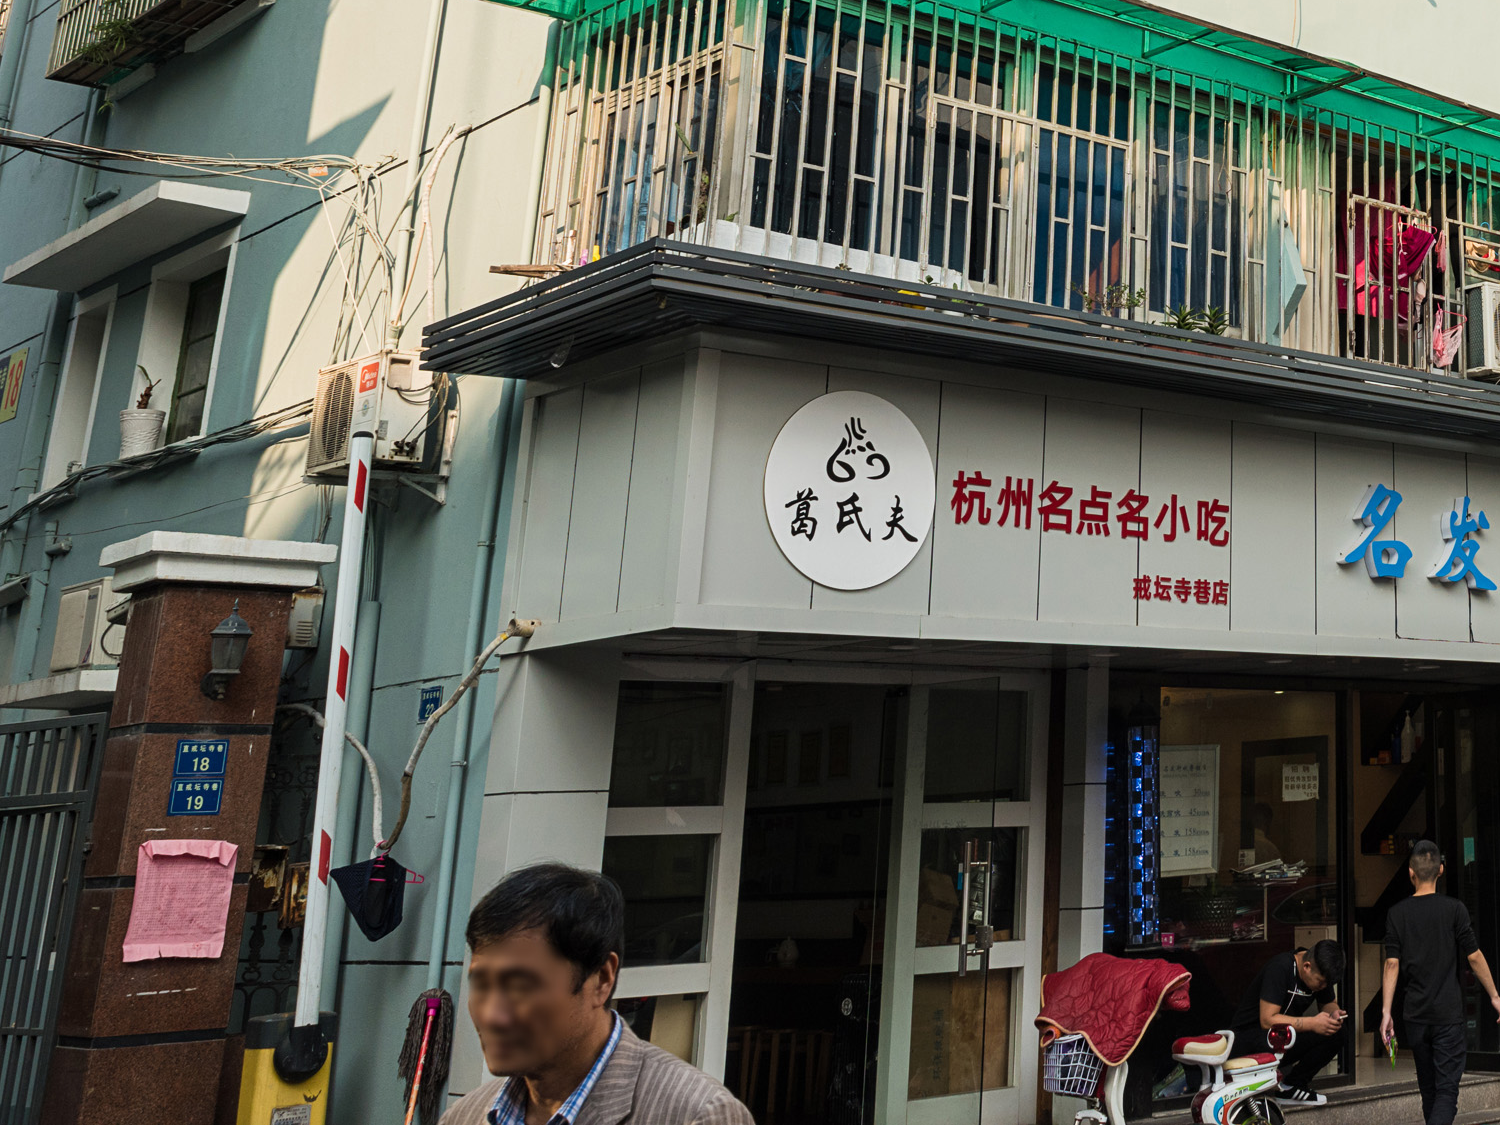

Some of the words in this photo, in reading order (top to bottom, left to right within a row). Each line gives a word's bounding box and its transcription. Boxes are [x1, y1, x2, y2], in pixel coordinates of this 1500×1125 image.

[4, 359, 23, 410] 18
[785, 487, 919, 543] 葛氏夫
[951, 470, 1230, 547] 杭州名点名小吃
[1132, 575, 1230, 606] 戒坛寺巷店
[193, 757, 210, 771] 18
[186, 796, 204, 810] 19
